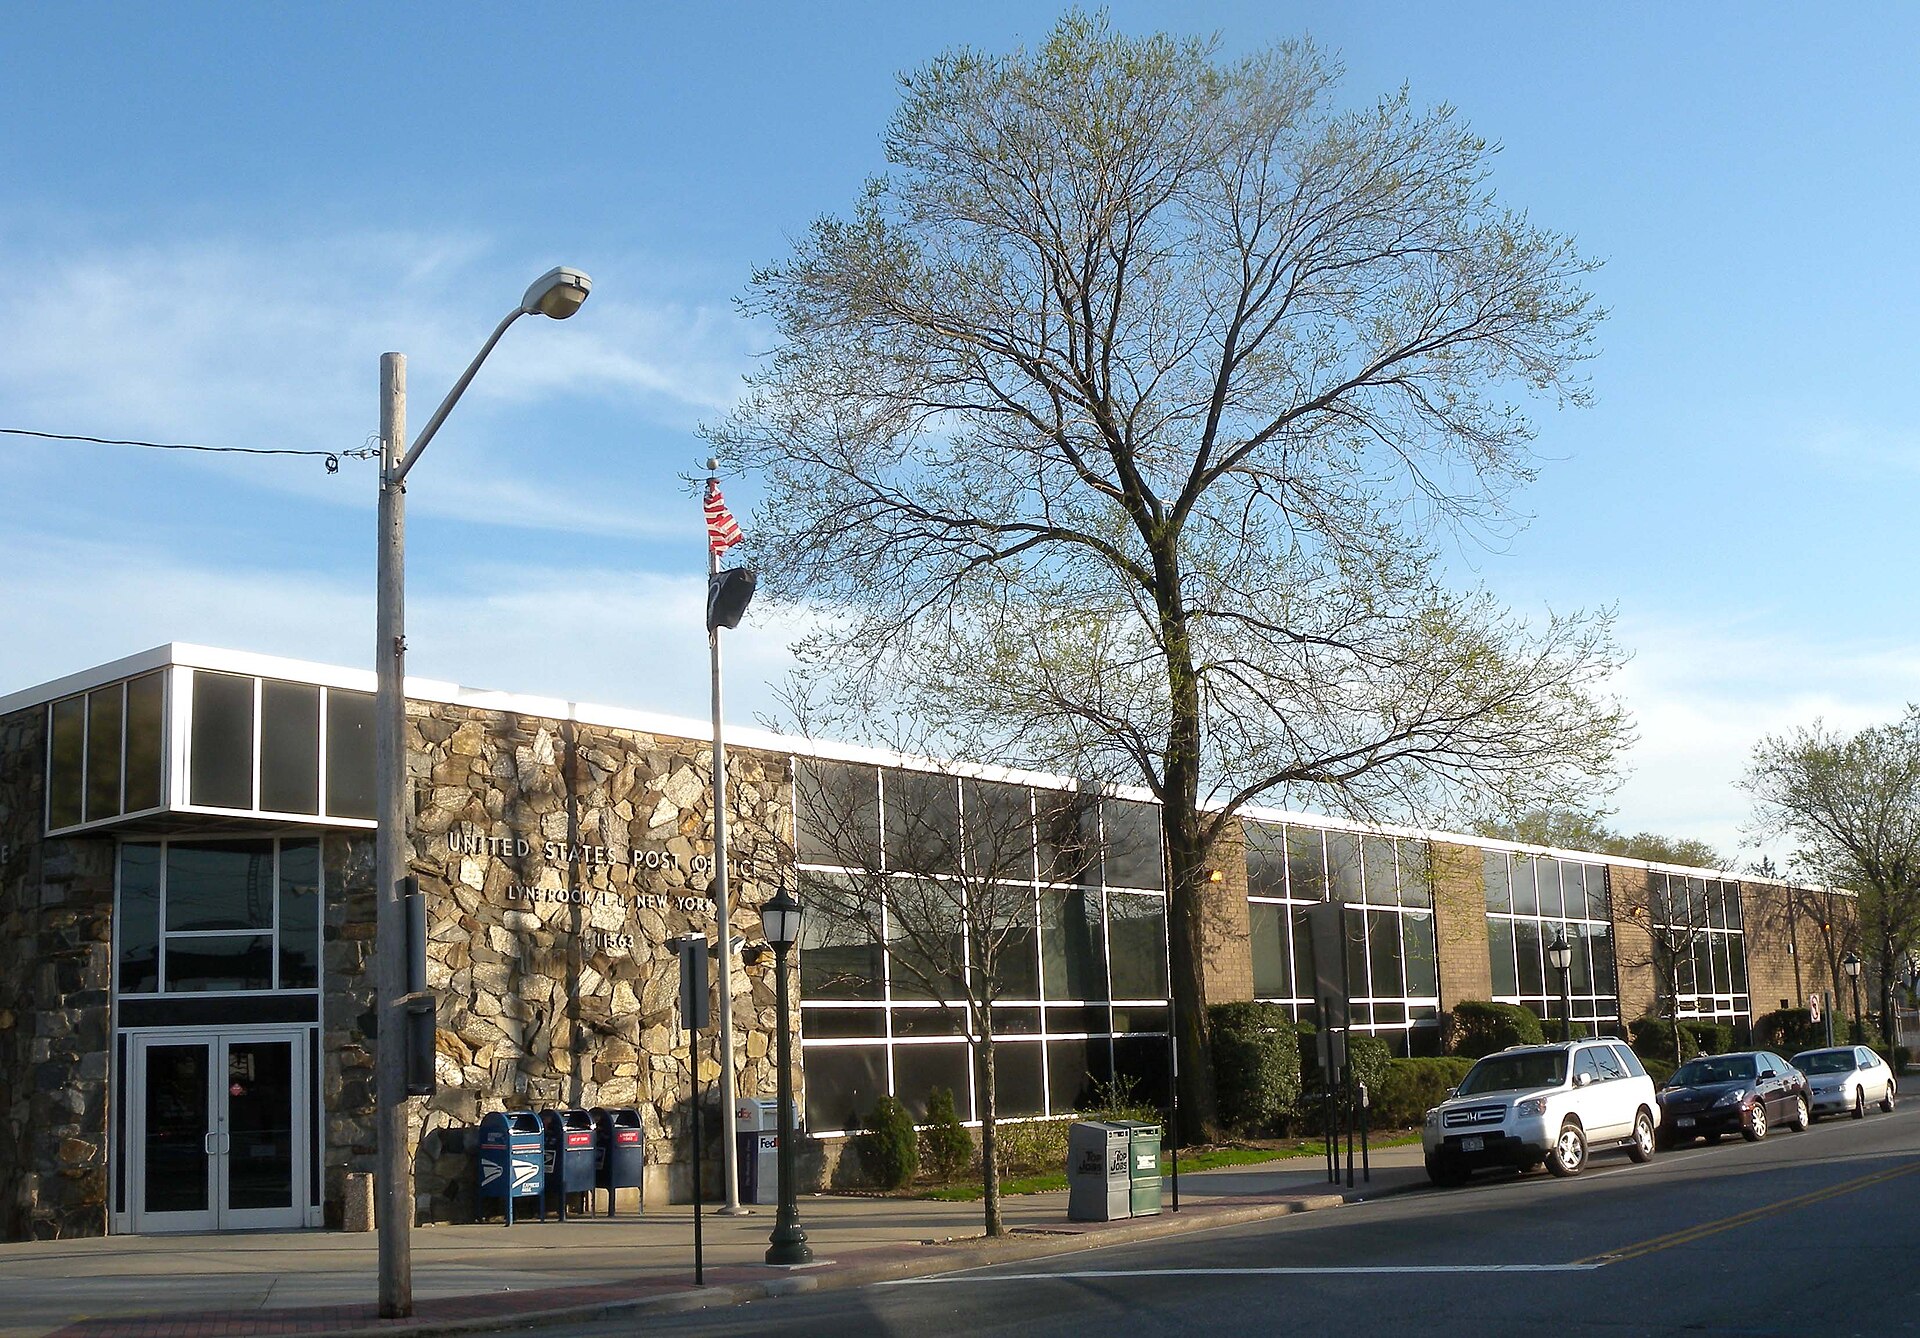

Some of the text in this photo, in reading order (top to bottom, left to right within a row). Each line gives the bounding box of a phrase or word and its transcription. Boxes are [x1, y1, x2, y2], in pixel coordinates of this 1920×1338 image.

[449, 831, 530, 857] UNITED
[545, 841, 617, 866] STATES
[634, 849, 681, 870] POST
[637, 895, 667, 908] NEW
[677, 896, 713, 913] YORK
[597, 933, 634, 949] 11563
